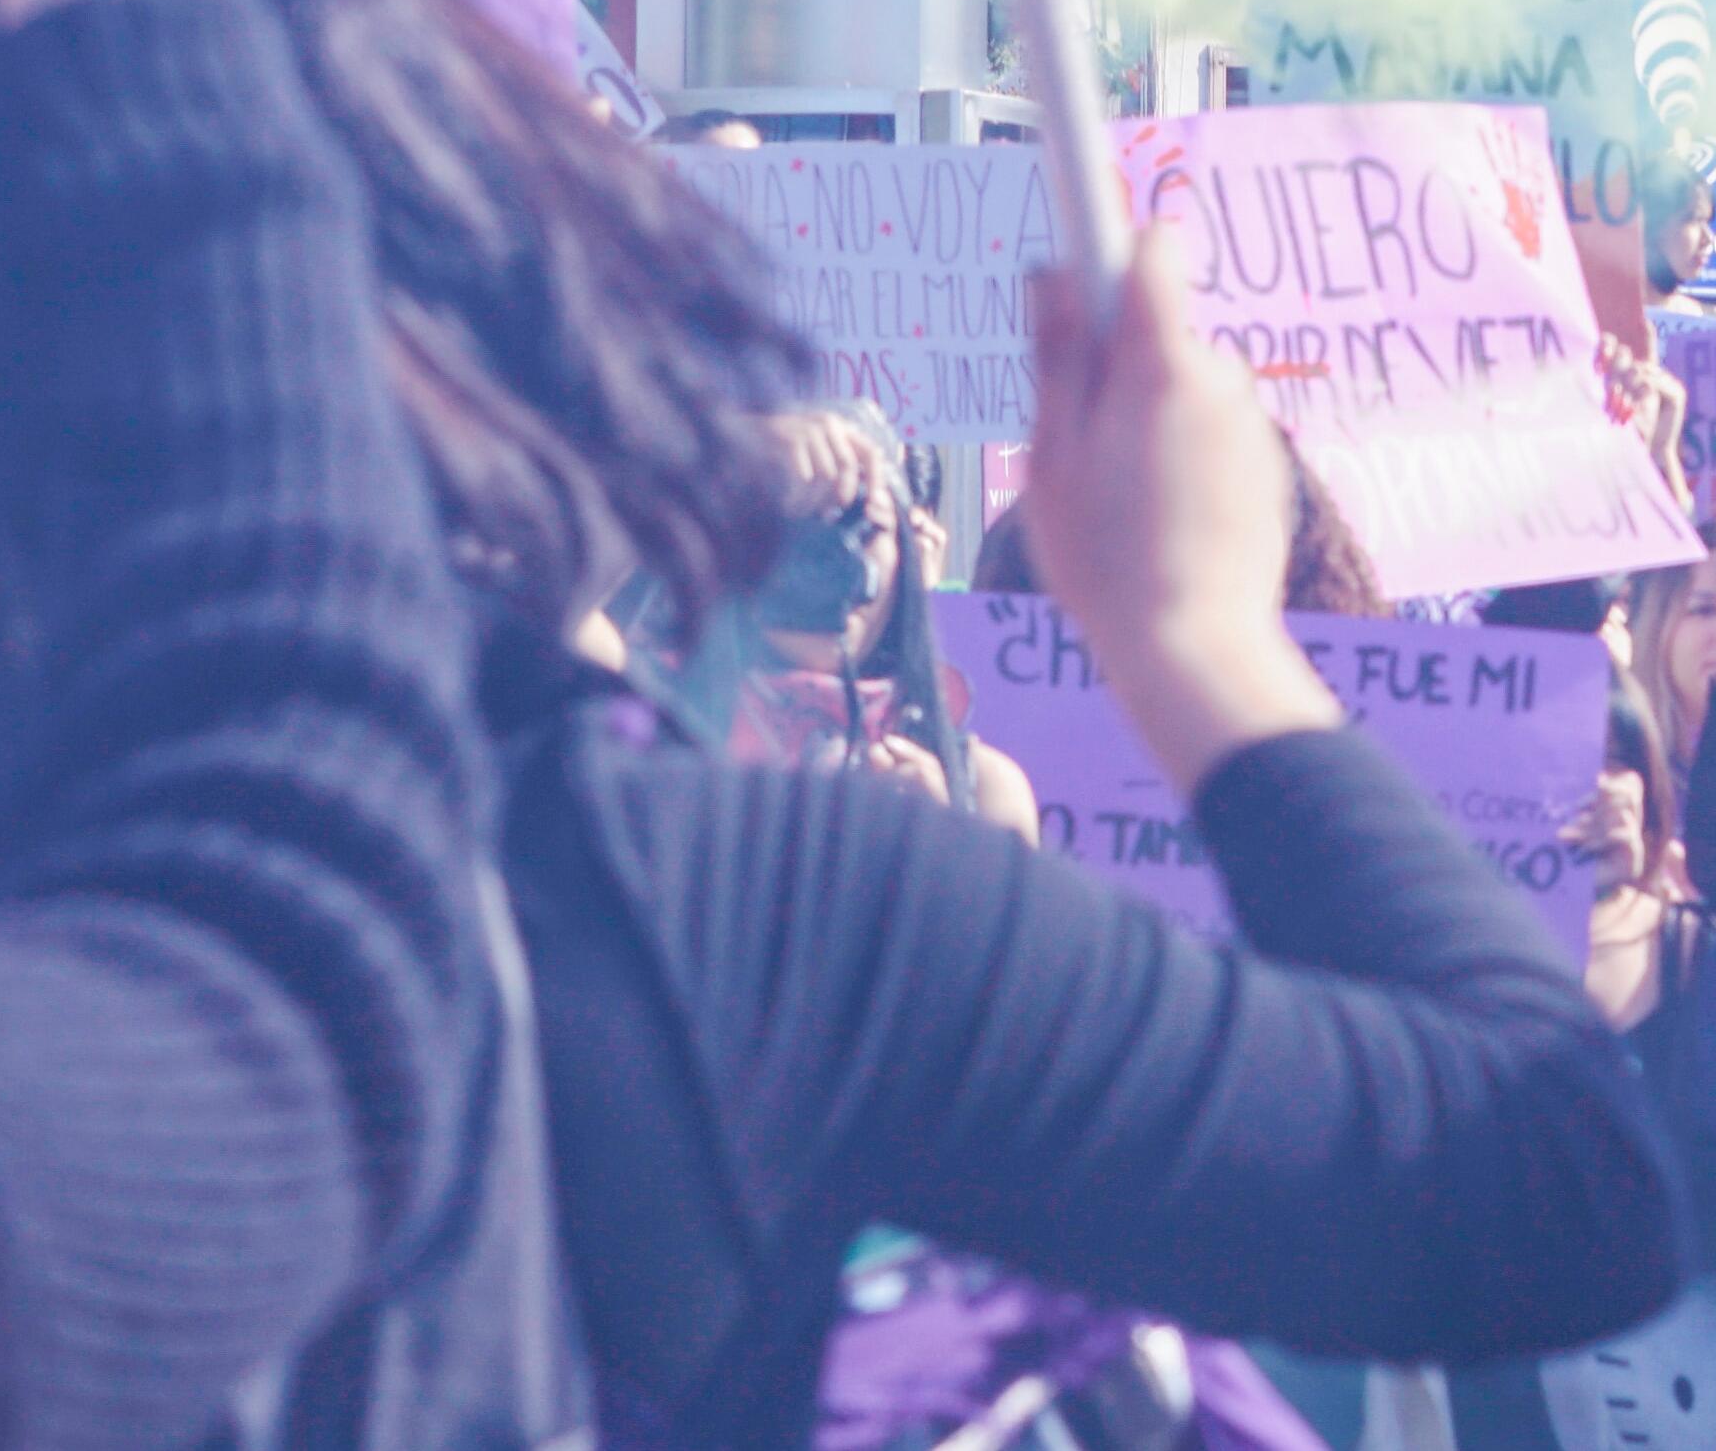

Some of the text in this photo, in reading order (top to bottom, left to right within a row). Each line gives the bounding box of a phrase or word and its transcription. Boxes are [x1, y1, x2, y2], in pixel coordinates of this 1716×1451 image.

[812, 160, 876, 255] NO
[889, 158, 995, 265] VOY
[1016, 161, 1057, 264] A
[1354, 642, 1452, 707] FUE
[1467, 652, 1539, 714] MI
